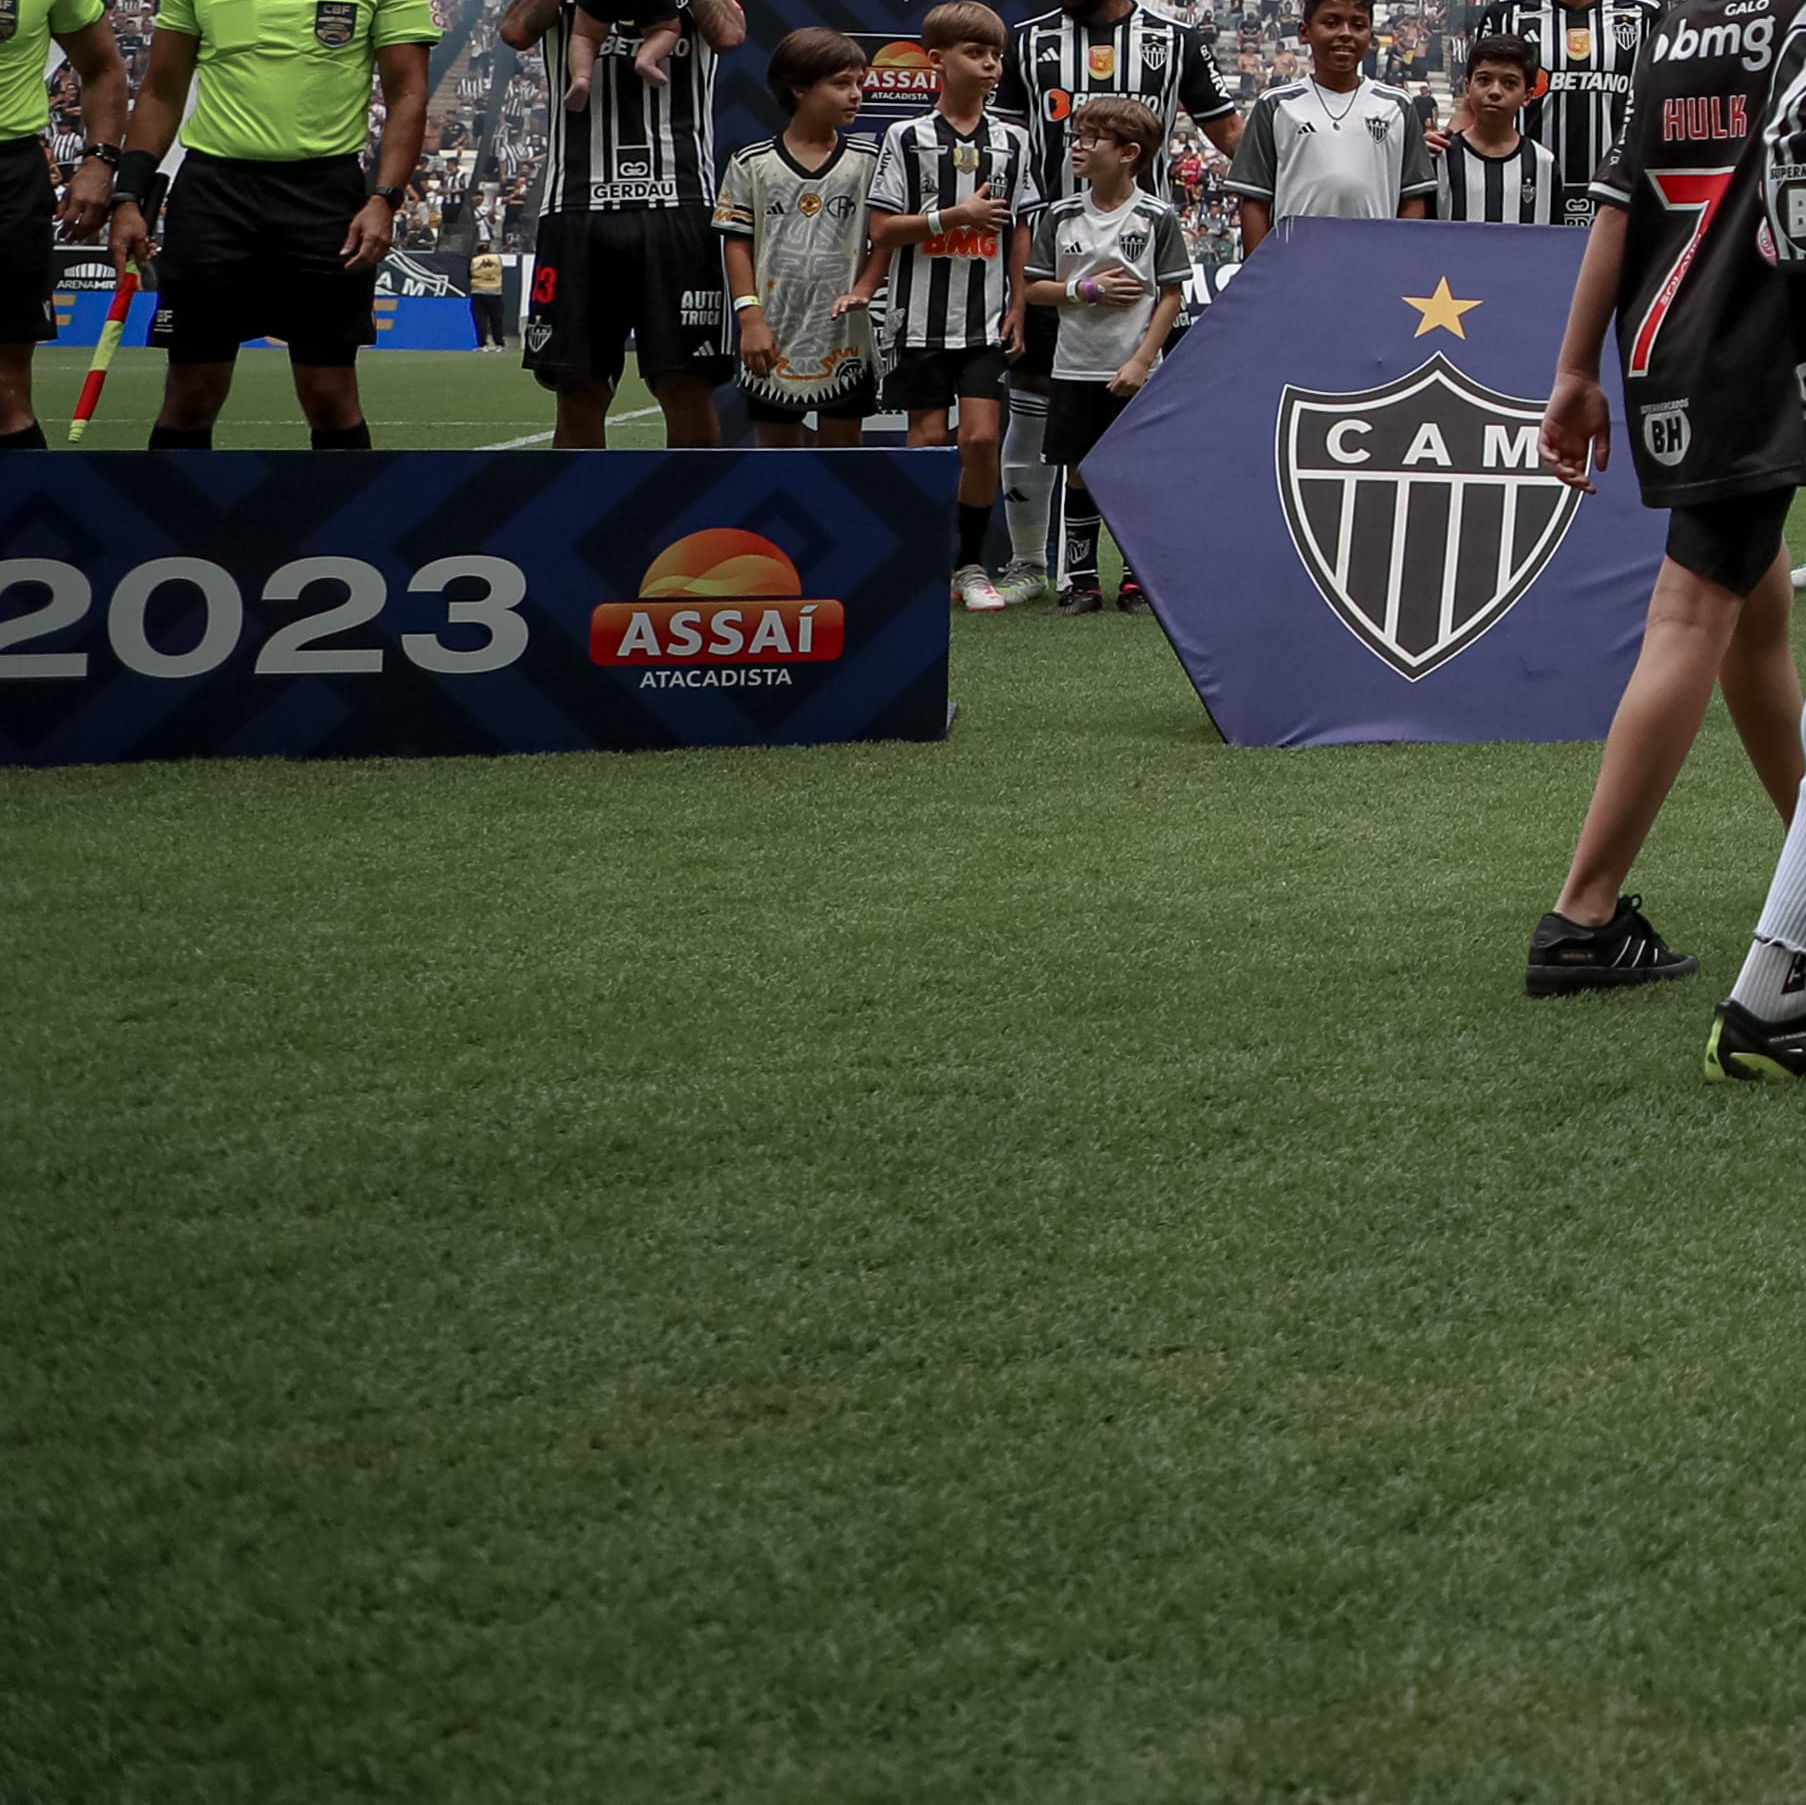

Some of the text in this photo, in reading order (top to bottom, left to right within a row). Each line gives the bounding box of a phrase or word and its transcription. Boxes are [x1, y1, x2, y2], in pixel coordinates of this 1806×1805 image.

[323, 3, 351, 14] CBF
[600, 37, 690, 56] BETO
[1668, 15, 1776, 71] bmg
[1208, 60, 1230, 98] MRV
[1550, 71, 1629, 93] BETANO
[1663, 95, 1746, 141] HULK
[594, 184, 674, 200] GERDAU
[1628, 167, 1737, 378] 7
[1651, 415, 1683, 454] BH
[0, 555, 530, 678] 2023
[640, 669, 792, 688] ATACADISTA
